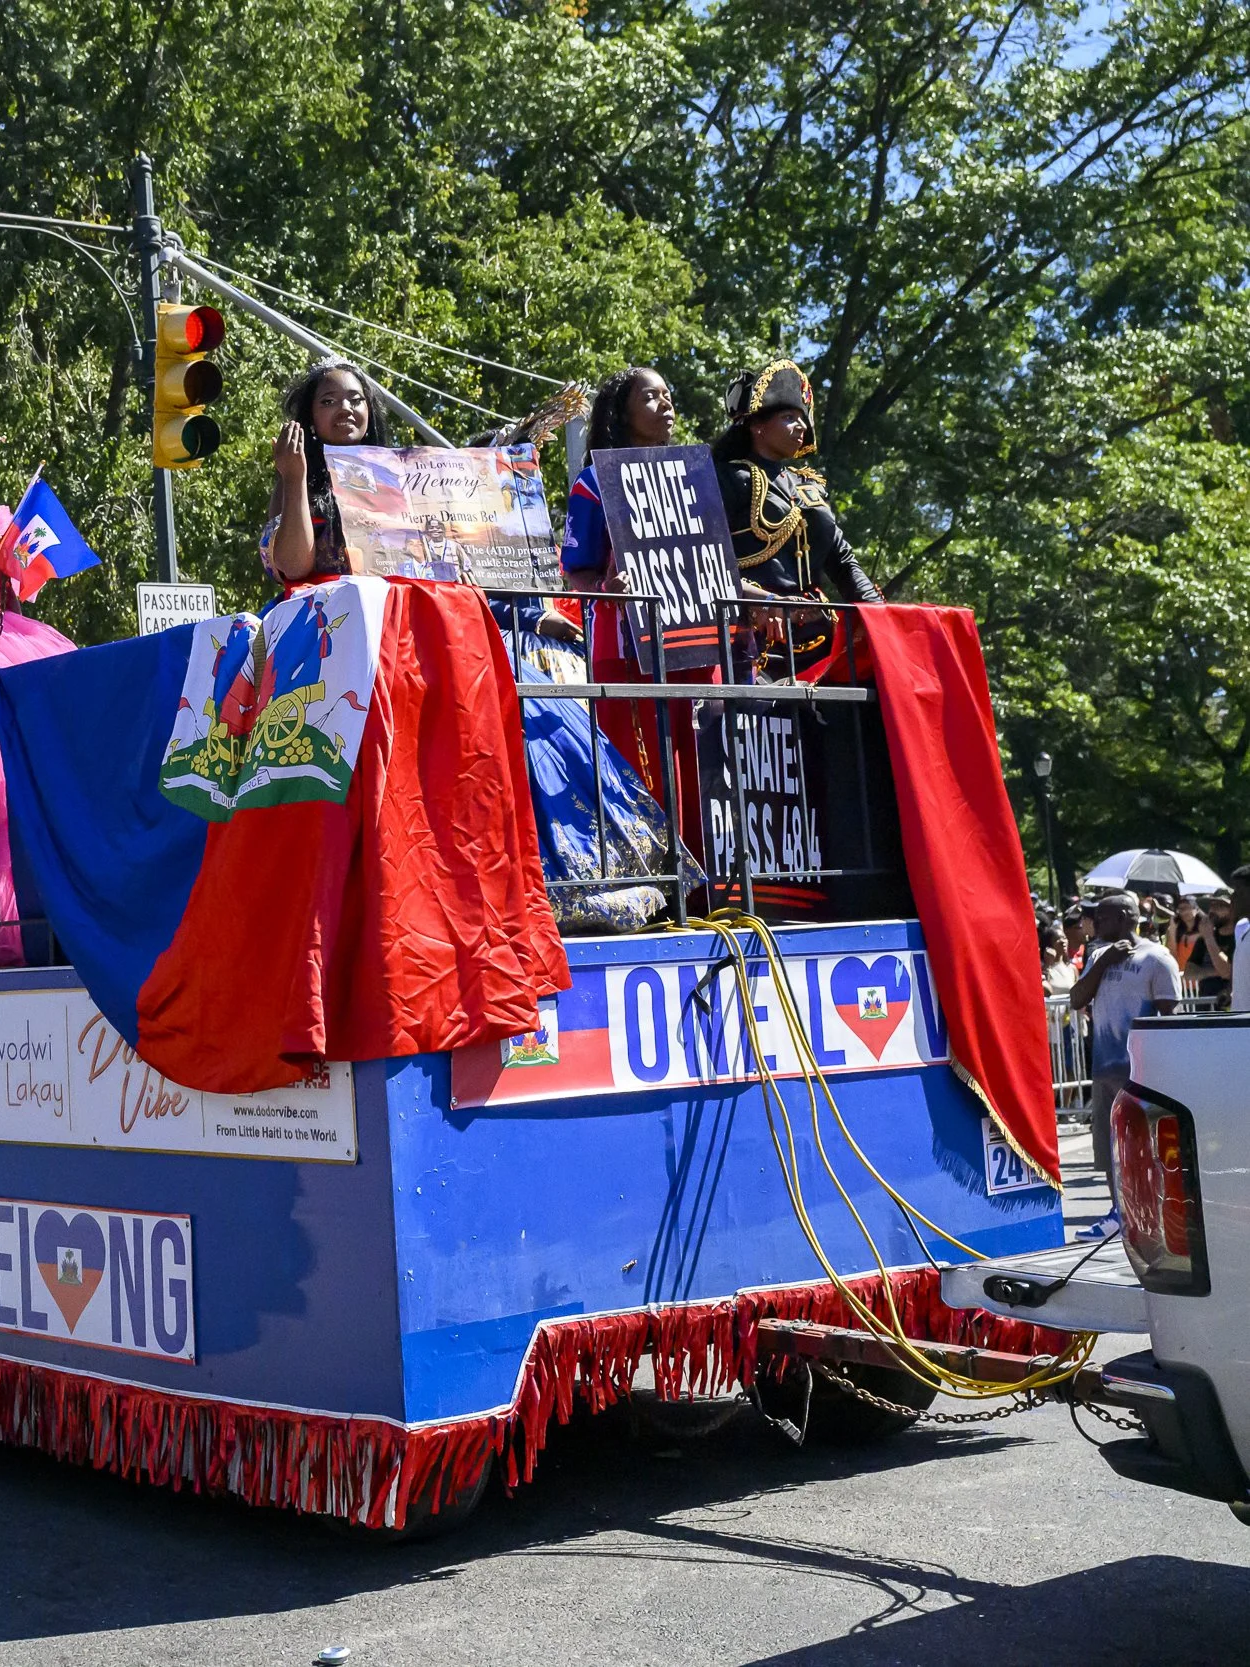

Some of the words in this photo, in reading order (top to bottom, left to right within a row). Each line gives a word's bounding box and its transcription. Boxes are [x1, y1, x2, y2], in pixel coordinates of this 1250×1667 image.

[415, 461, 427, 470] In
[430, 461, 465, 471] Loving
[399, 472, 488, 498] Memory
[621, 460, 704, 539] SENATE:
[401, 511, 437, 524] Pierre
[440, 510, 478, 523] Damas
[464, 545, 484, 555] The
[486, 545, 516, 557] (ATD)
[476, 559, 501, 567] ankle
[503, 558, 542, 568] bracelet
[543, 556, 552, 565] is
[623, 548, 682, 629] PASS
[691, 543, 740, 620] 4814
[143, 593, 209, 611] PASSENGER
[145, 617, 174, 634] CARS
[710, 798, 761, 877] PAS
[782, 805, 822, 883] 484
[624, 960, 778, 1084] ONE
[6, 1061, 64, 1118] Lakay
[120, 1064, 189, 1134] Vibe
[233, 1105, 319, 1120] www.dodorvibe.com
[216, 1124, 237, 1137] From
[238, 1125, 261, 1139] Little
[262, 1126, 282, 1140] Haiti
[284, 1128, 293, 1140] to
[295, 1128, 309, 1141] the
[310, 1128, 338, 1142] World
[992, 1146, 1024, 1187] 24
